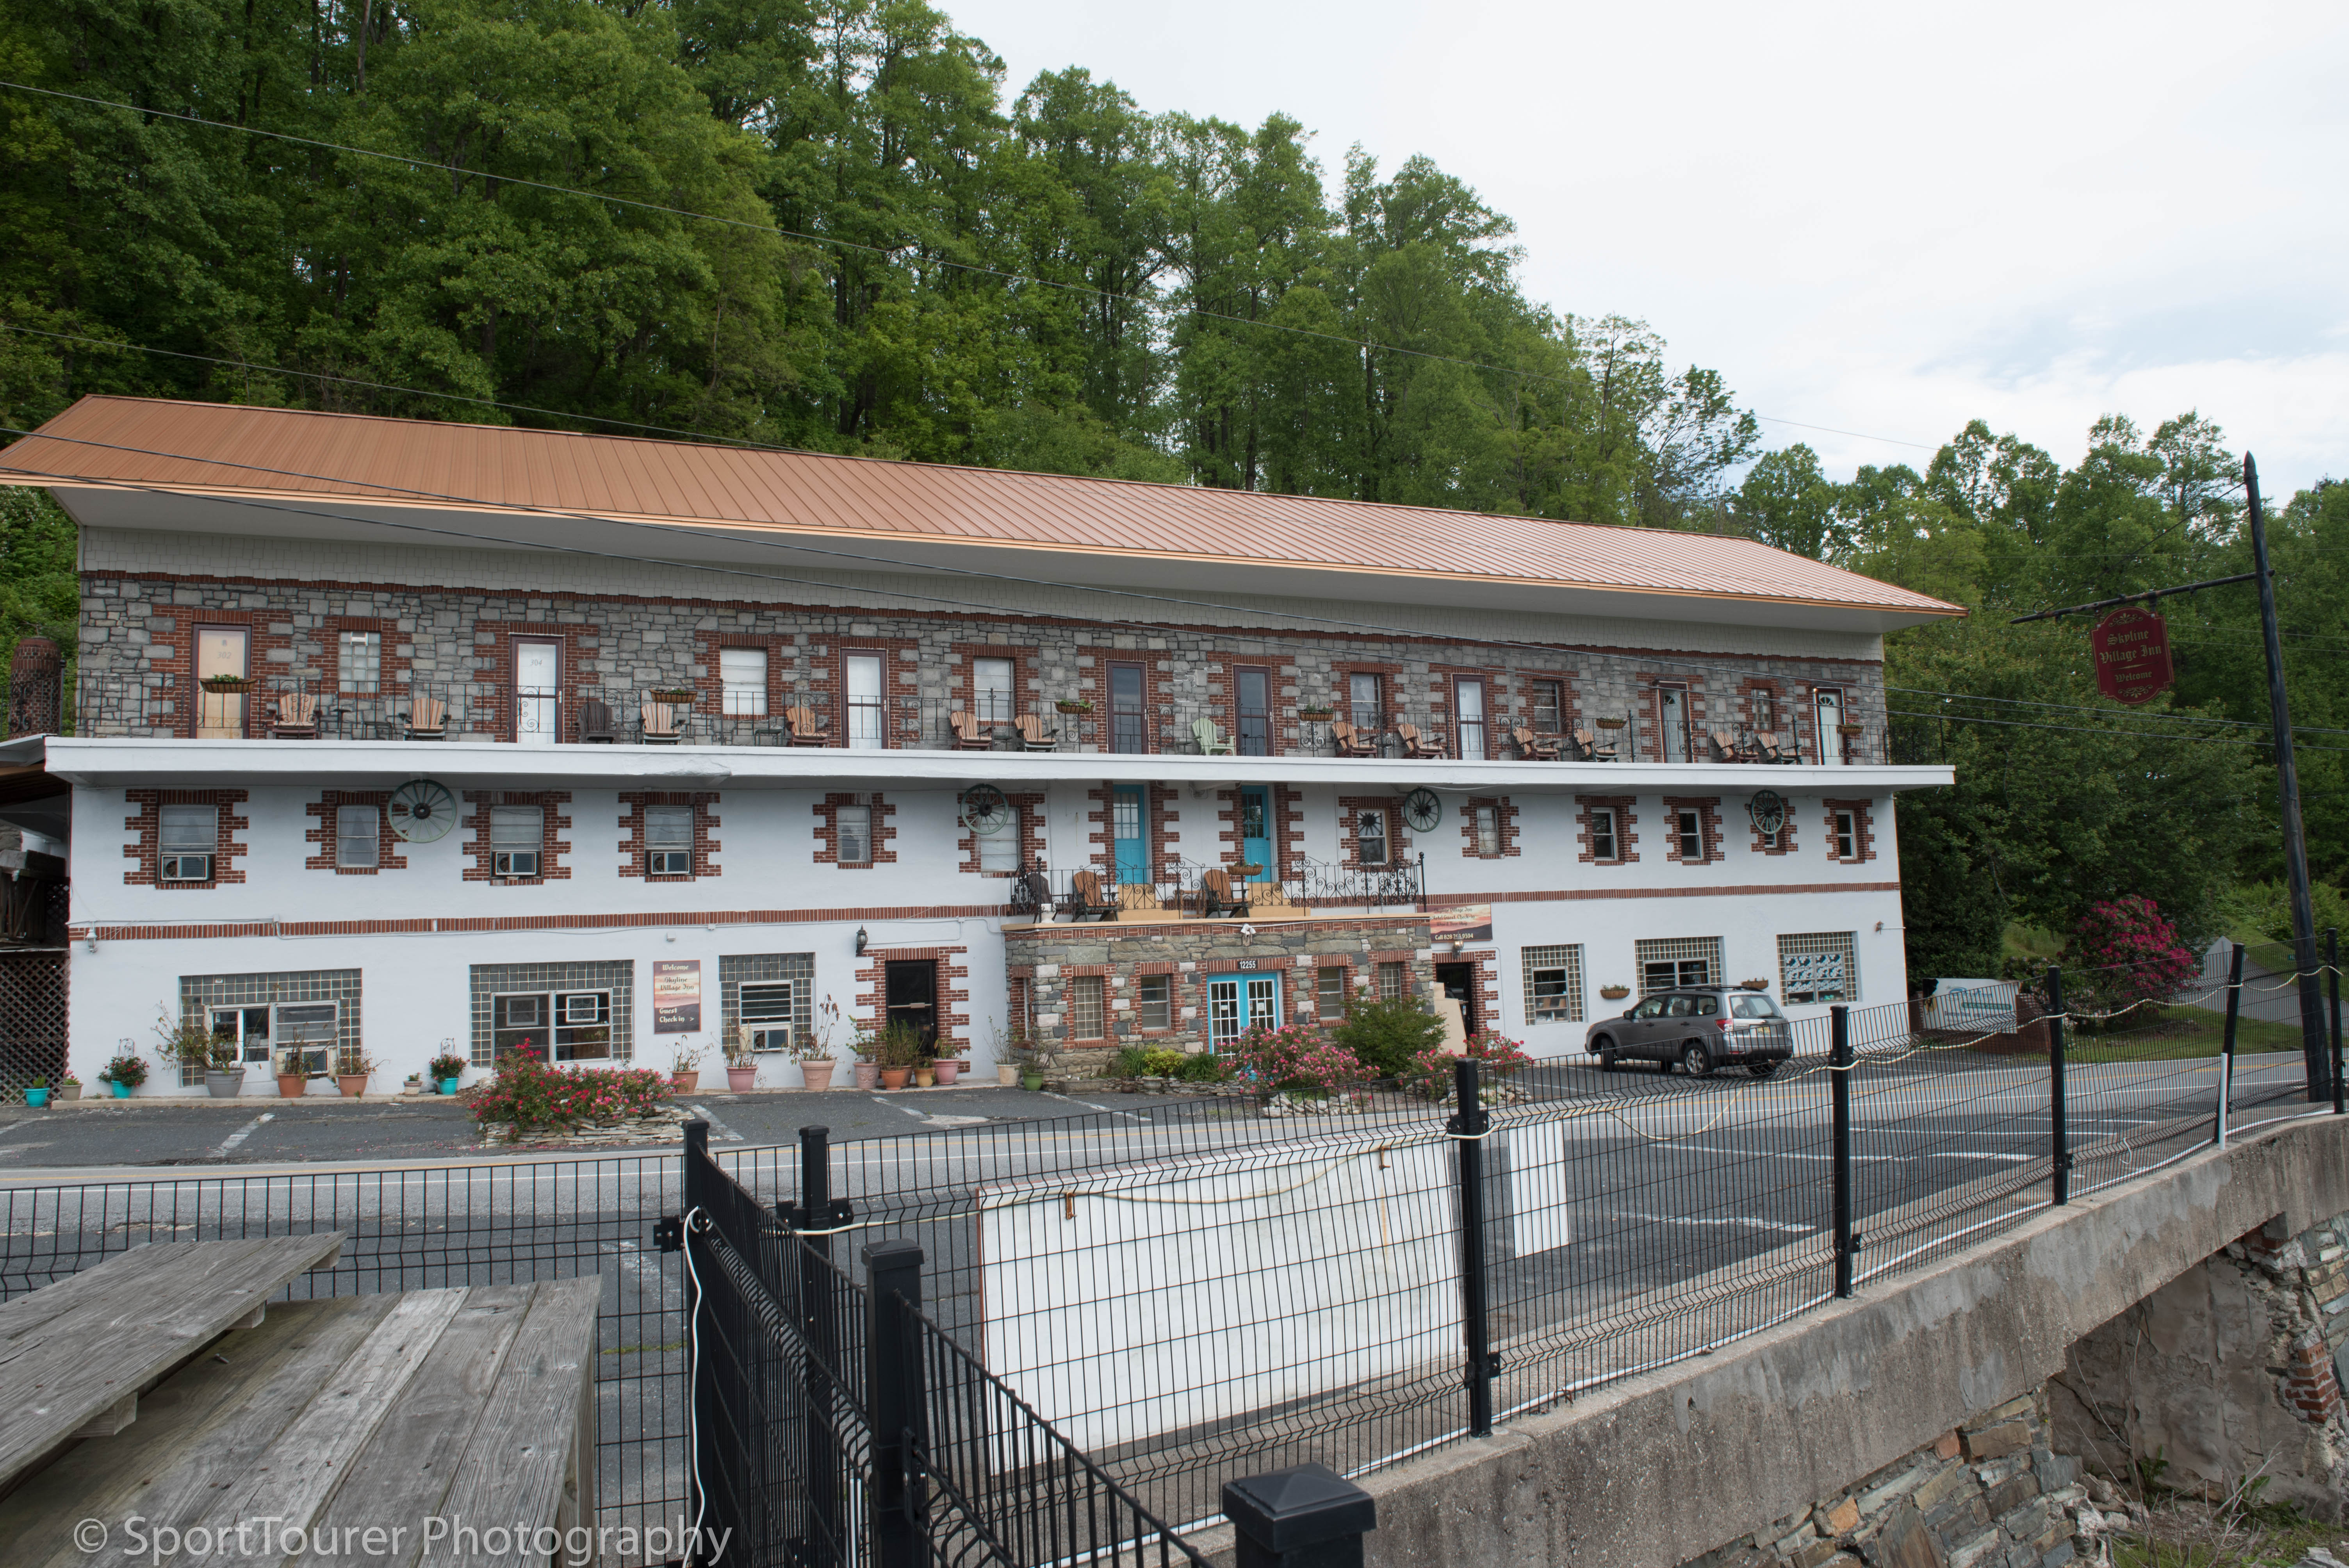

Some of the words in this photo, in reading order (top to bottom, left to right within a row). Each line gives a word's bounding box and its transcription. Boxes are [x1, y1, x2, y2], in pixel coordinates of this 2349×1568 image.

[2107, 630, 2149, 646] Skyline
[2099, 650, 2137, 664] Village
[2140, 645, 2162, 657] Inn
[2115, 671, 2152, 682] Welcome
[1240, 960, 1256, 969] 12255
